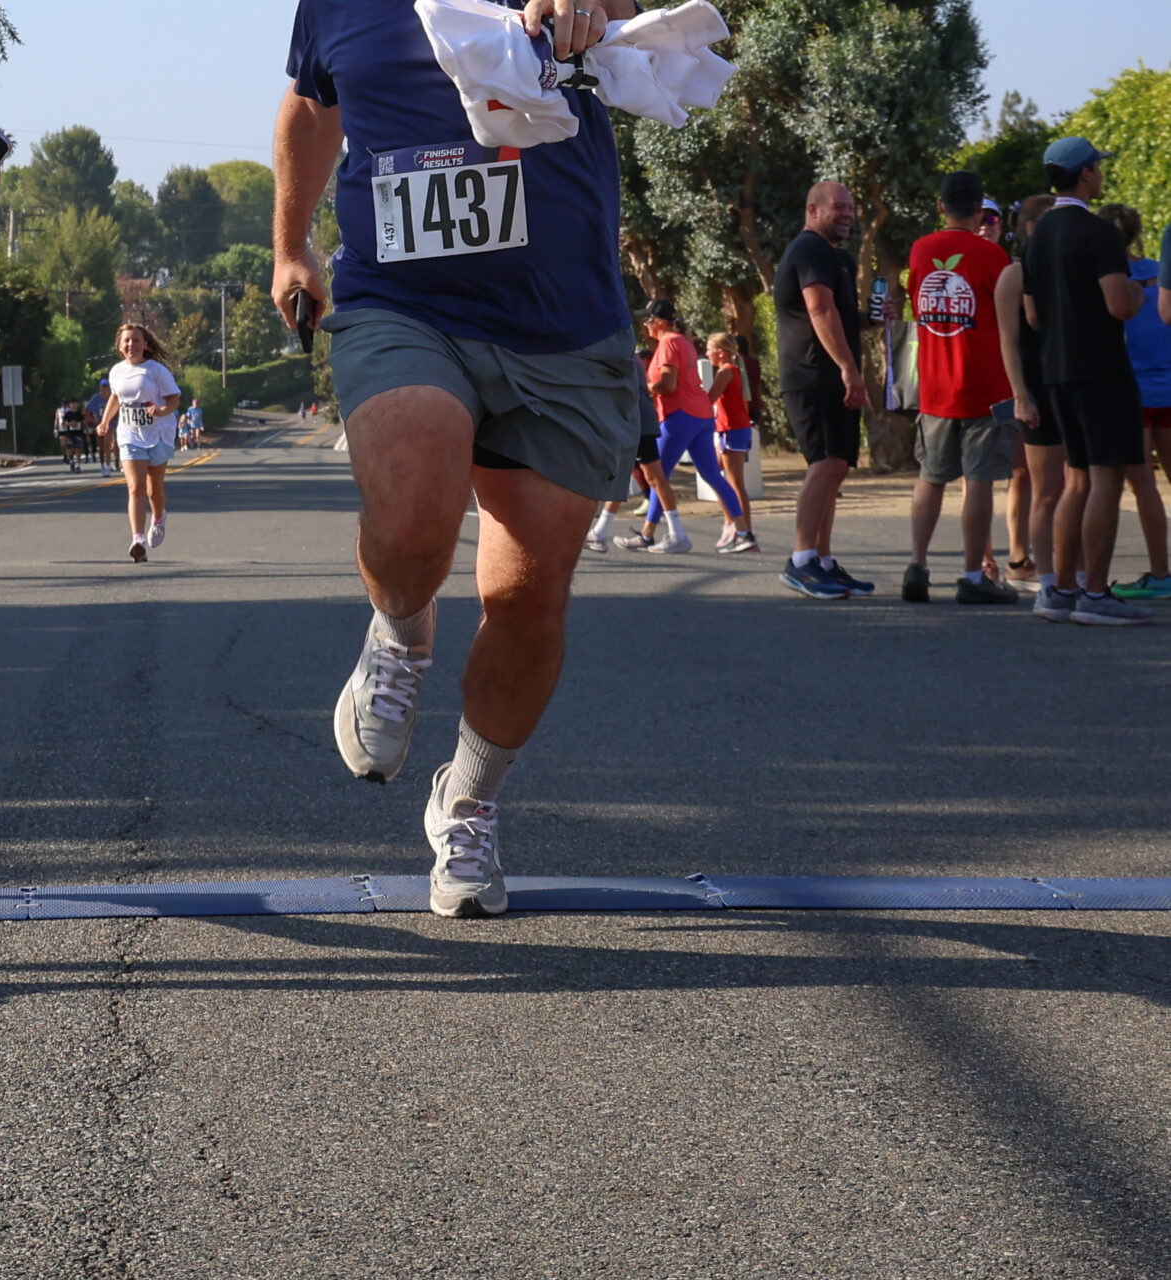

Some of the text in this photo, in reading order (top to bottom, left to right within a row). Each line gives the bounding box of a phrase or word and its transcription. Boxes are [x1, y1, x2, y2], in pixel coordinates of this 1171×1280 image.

[424, 147, 465, 159] FINISHED
[423, 157, 463, 169] RESULTS
[394, 165, 519, 253] 1437
[383, 222, 395, 248] 1437
